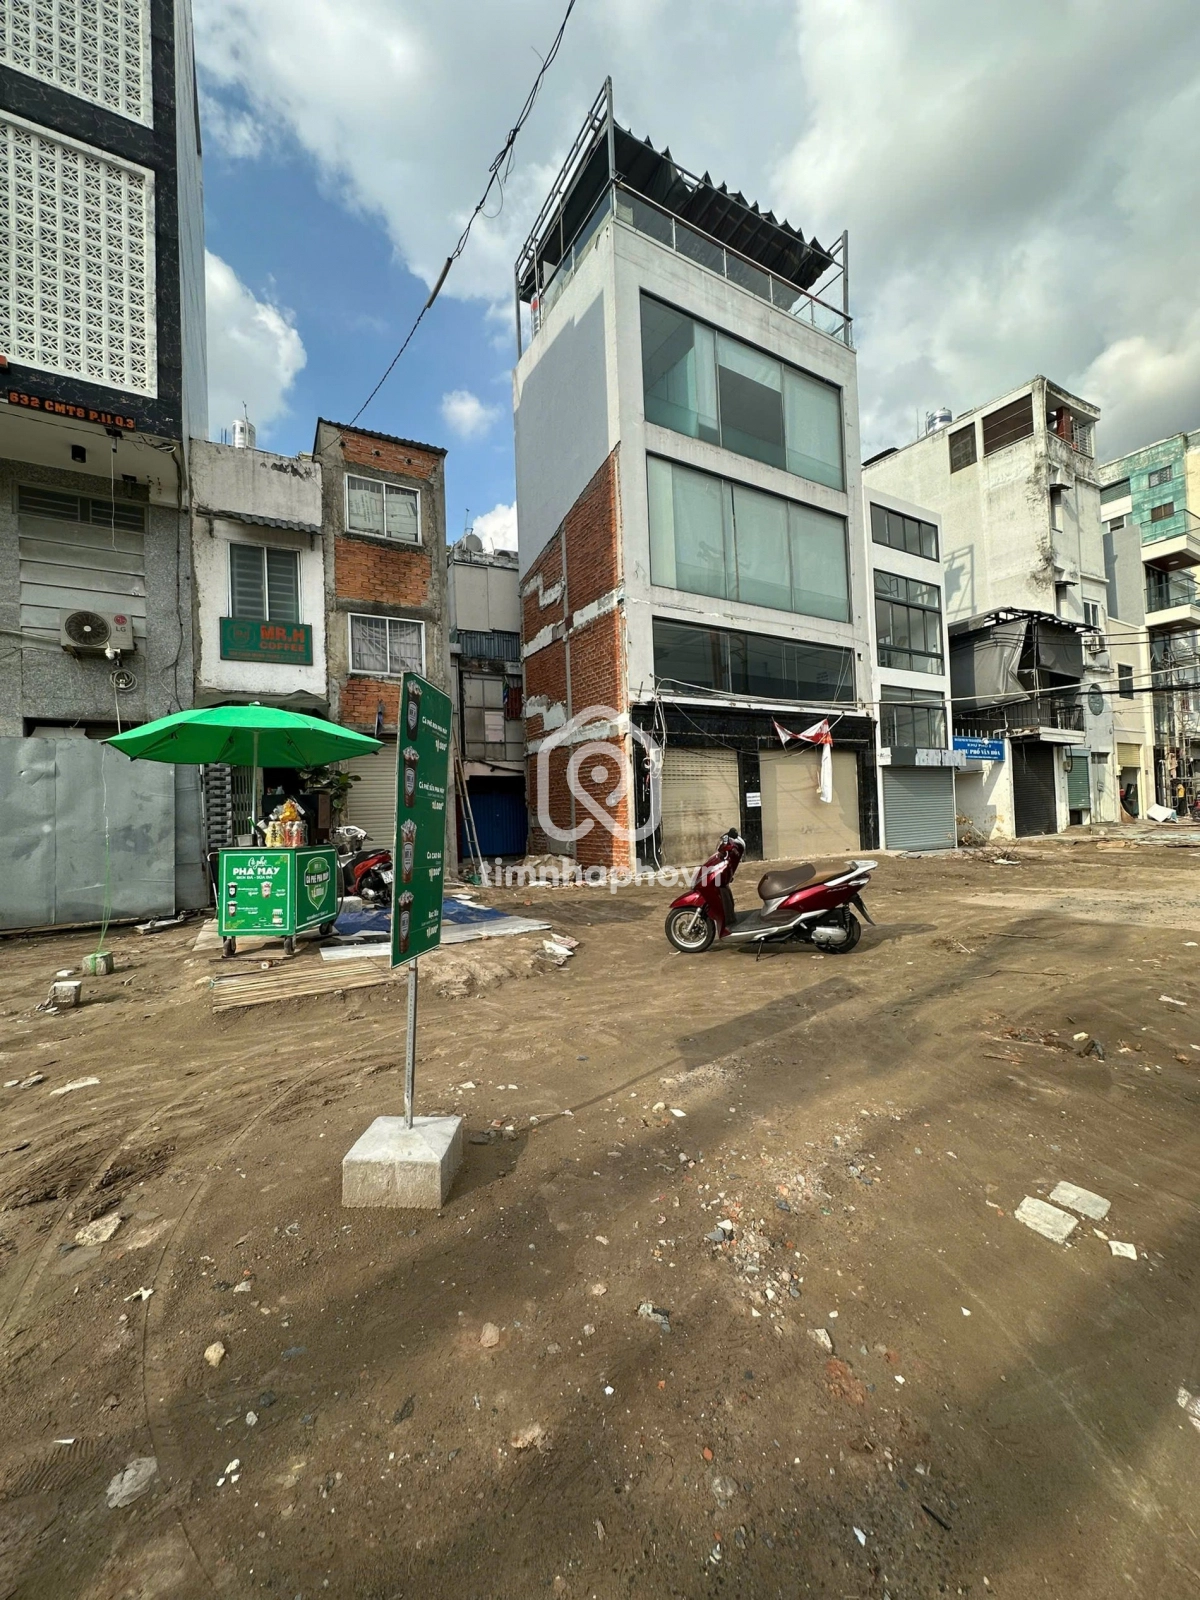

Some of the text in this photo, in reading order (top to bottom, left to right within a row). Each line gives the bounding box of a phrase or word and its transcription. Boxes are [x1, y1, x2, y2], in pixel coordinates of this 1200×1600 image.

[9, 392, 40, 408] 632
[45, 401, 85, 417] CMT8
[261, 625, 304, 642] MR.H
[260, 641, 304, 652] COFFEE
[233, 867, 254, 875] PHA
